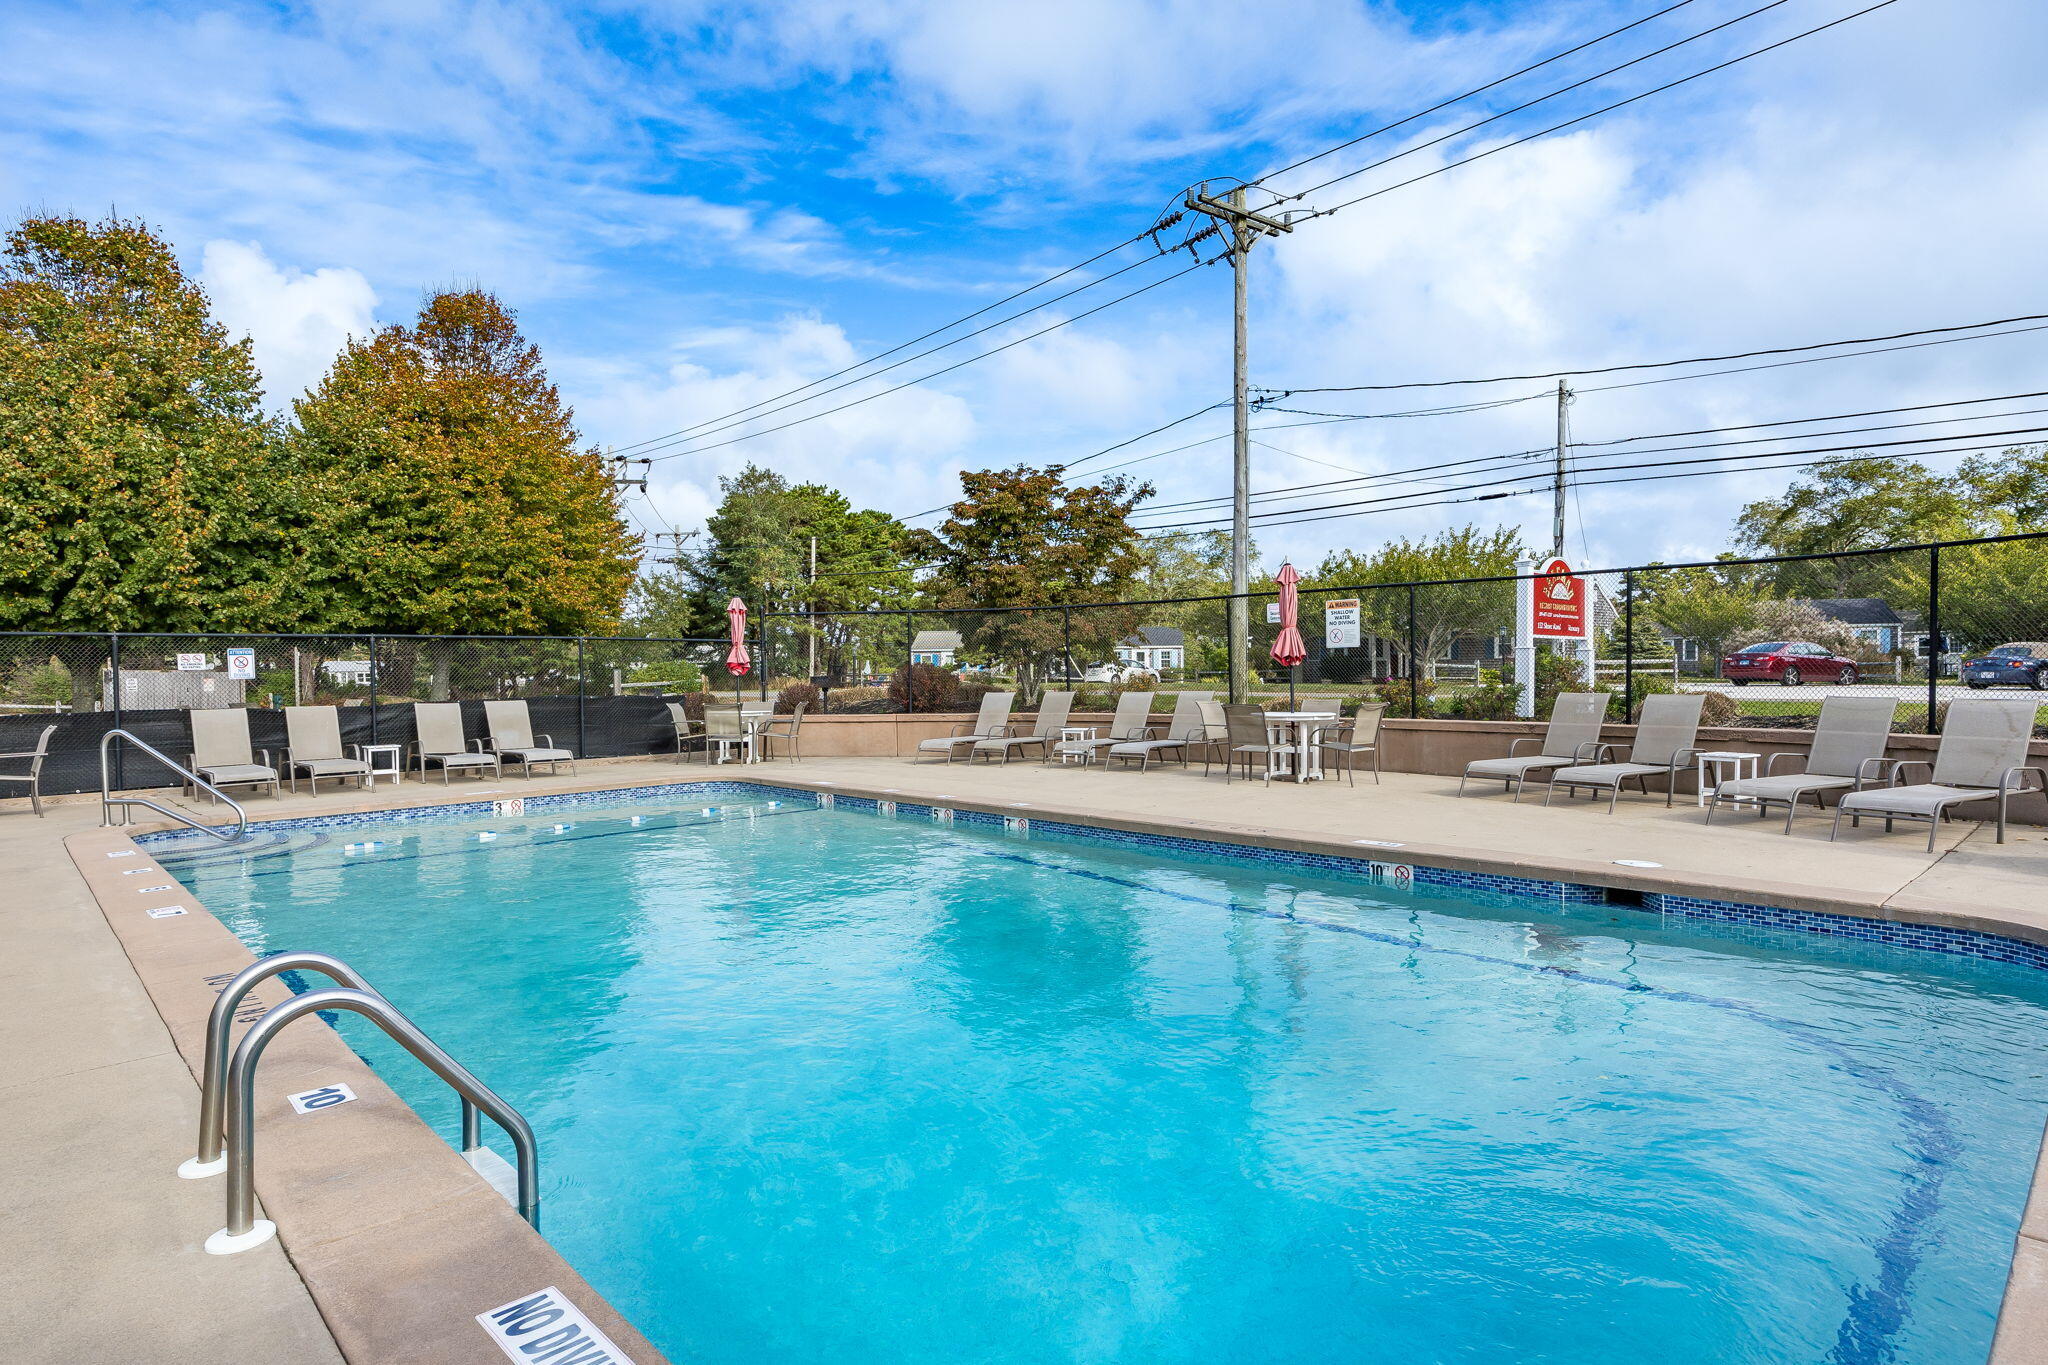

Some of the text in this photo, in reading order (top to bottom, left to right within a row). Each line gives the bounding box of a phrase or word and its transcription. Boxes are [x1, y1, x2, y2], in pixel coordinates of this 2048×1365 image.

[300, 1088, 346, 1109] 10
[491, 1294, 618, 1365] NO DIV
